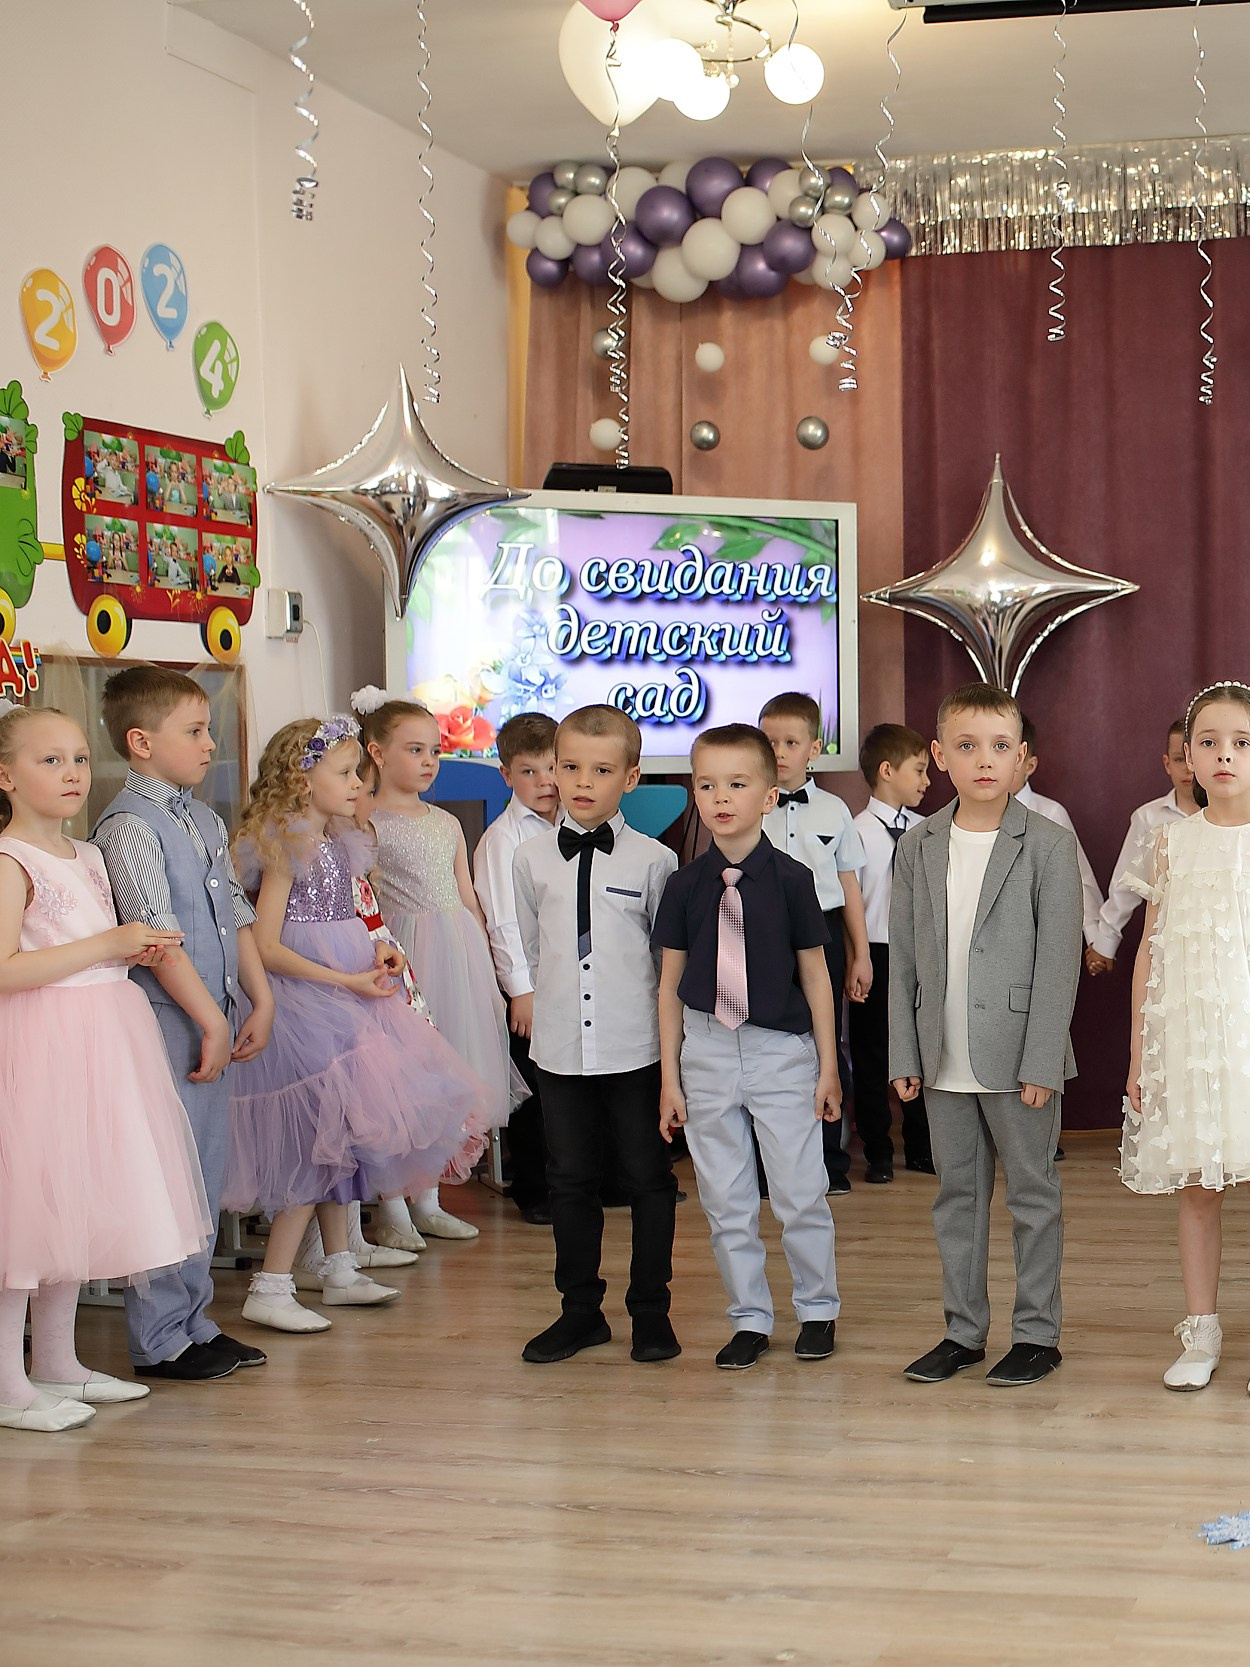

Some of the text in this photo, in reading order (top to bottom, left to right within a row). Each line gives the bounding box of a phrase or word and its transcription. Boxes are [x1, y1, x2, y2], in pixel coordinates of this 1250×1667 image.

[484, 542, 836, 600] До свидания
[546, 604, 788, 660] детский
[606, 666, 704, 719] сад
